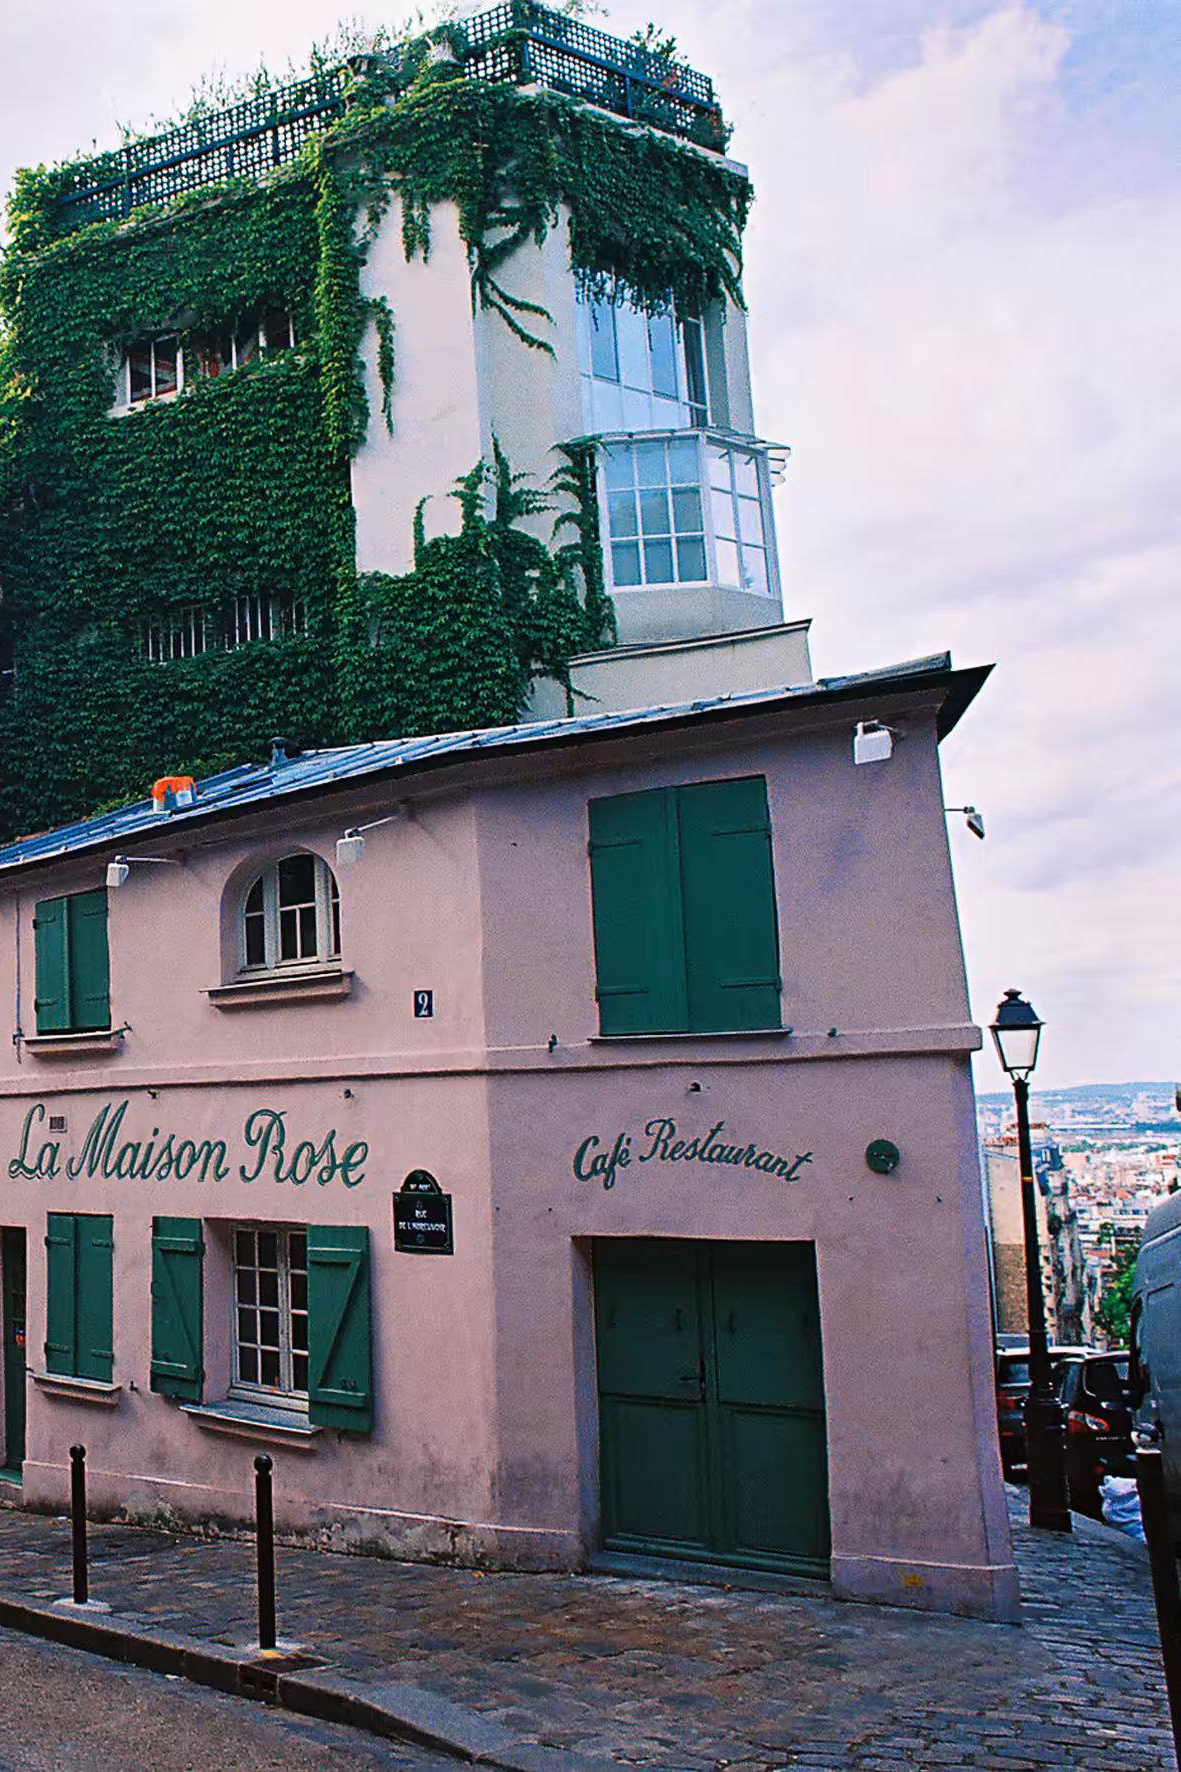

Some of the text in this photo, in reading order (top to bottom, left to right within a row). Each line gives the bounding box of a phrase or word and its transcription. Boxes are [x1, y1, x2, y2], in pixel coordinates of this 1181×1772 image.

[418, 992, 429, 1017] 2
[7, 1100, 369, 1189] La Maison Rose
[573, 1117, 813, 1190] Café Restaurant
